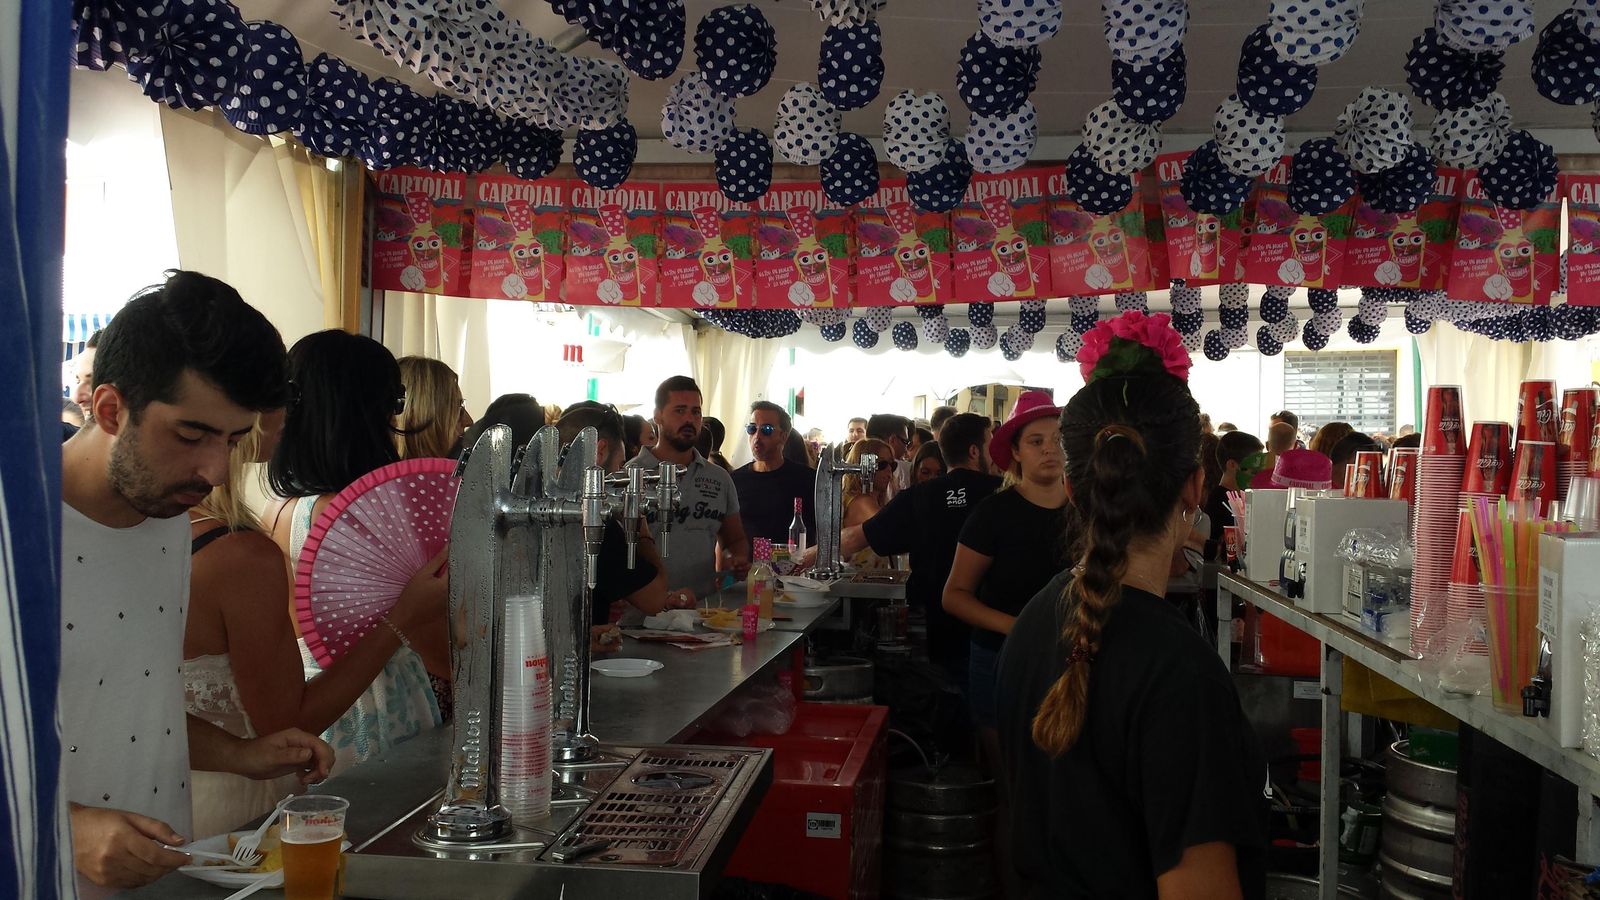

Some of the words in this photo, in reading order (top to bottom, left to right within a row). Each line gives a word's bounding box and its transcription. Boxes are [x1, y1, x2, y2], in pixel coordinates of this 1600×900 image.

[379, 173, 463, 200] CARTOJAL
[478, 182, 564, 208] CARTOJAL
[963, 176, 1043, 203] ARTOJAL
[571, 187, 657, 213] CARTOJAL
[759, 190, 845, 214] CARTOJA
[946, 487, 966, 500] 25
